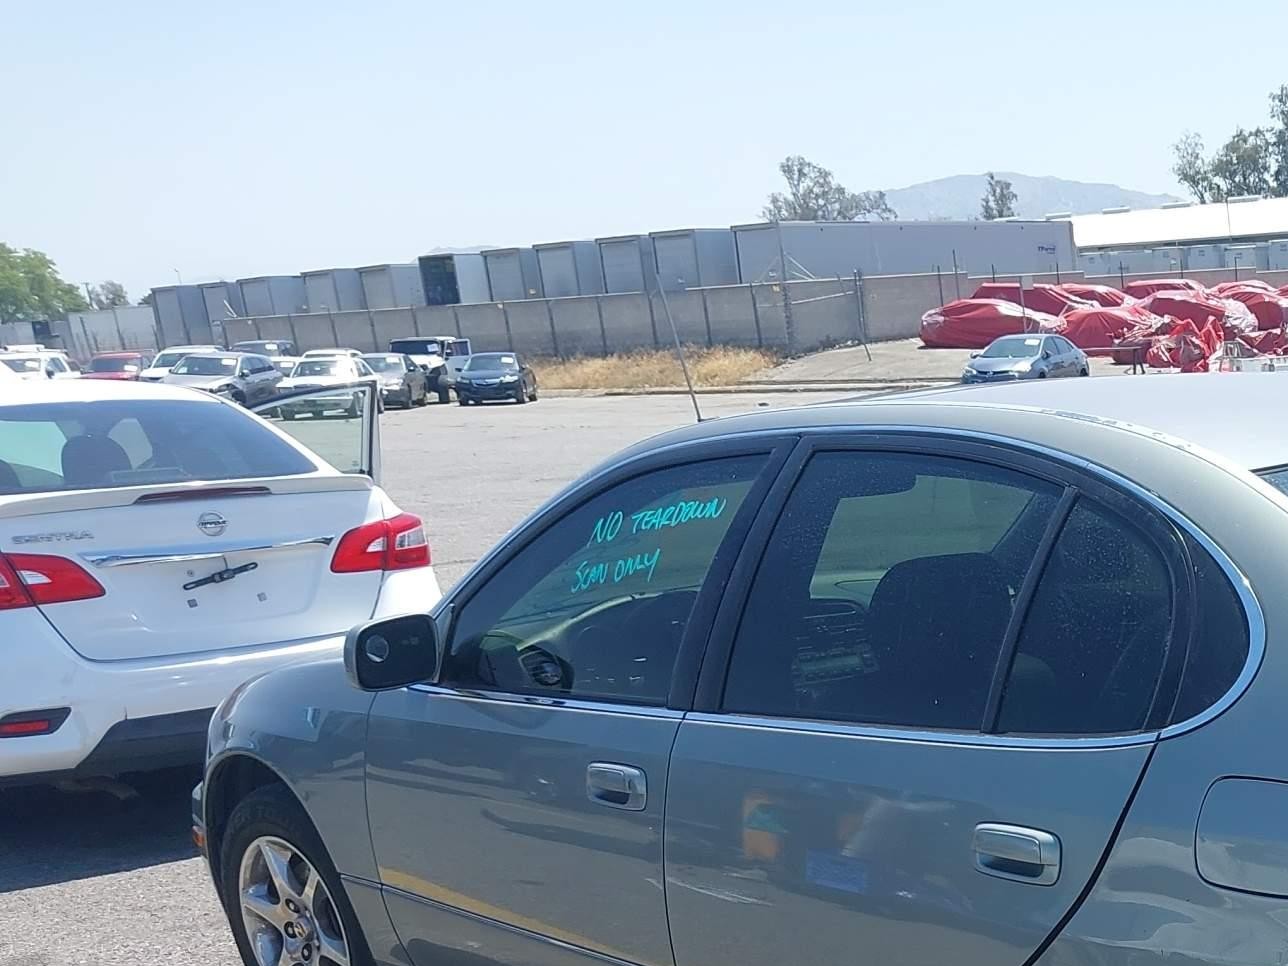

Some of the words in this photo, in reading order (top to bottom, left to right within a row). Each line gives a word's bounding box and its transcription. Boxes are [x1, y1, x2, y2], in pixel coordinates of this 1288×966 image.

[587, 511, 623, 548] NO
[632, 498, 727, 534] TEARDOWN
[571, 560, 609, 593] SCAN
[614, 549, 660, 582] ONLY
